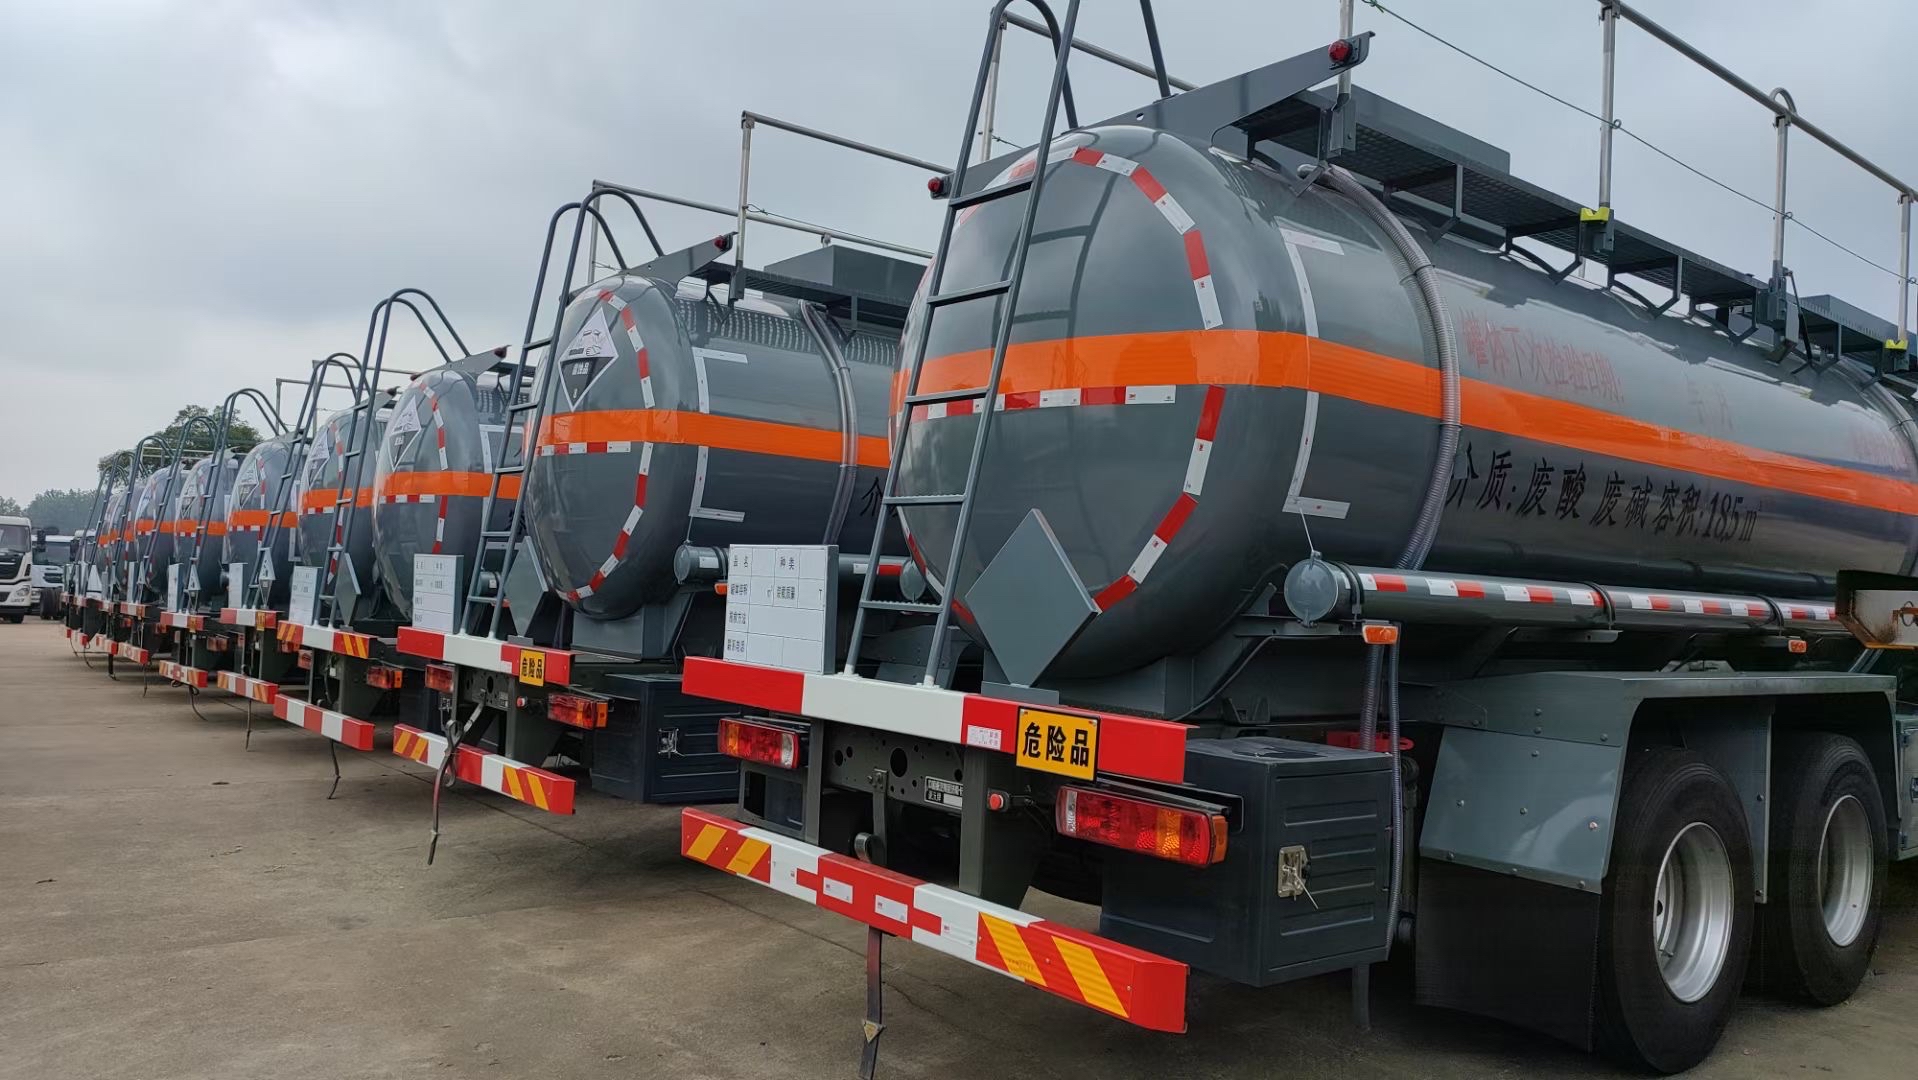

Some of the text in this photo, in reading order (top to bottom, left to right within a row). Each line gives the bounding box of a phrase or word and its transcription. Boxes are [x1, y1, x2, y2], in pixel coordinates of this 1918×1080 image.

[522, 657, 543, 680] 危险品
[1022, 721, 1090, 768] 危险品
